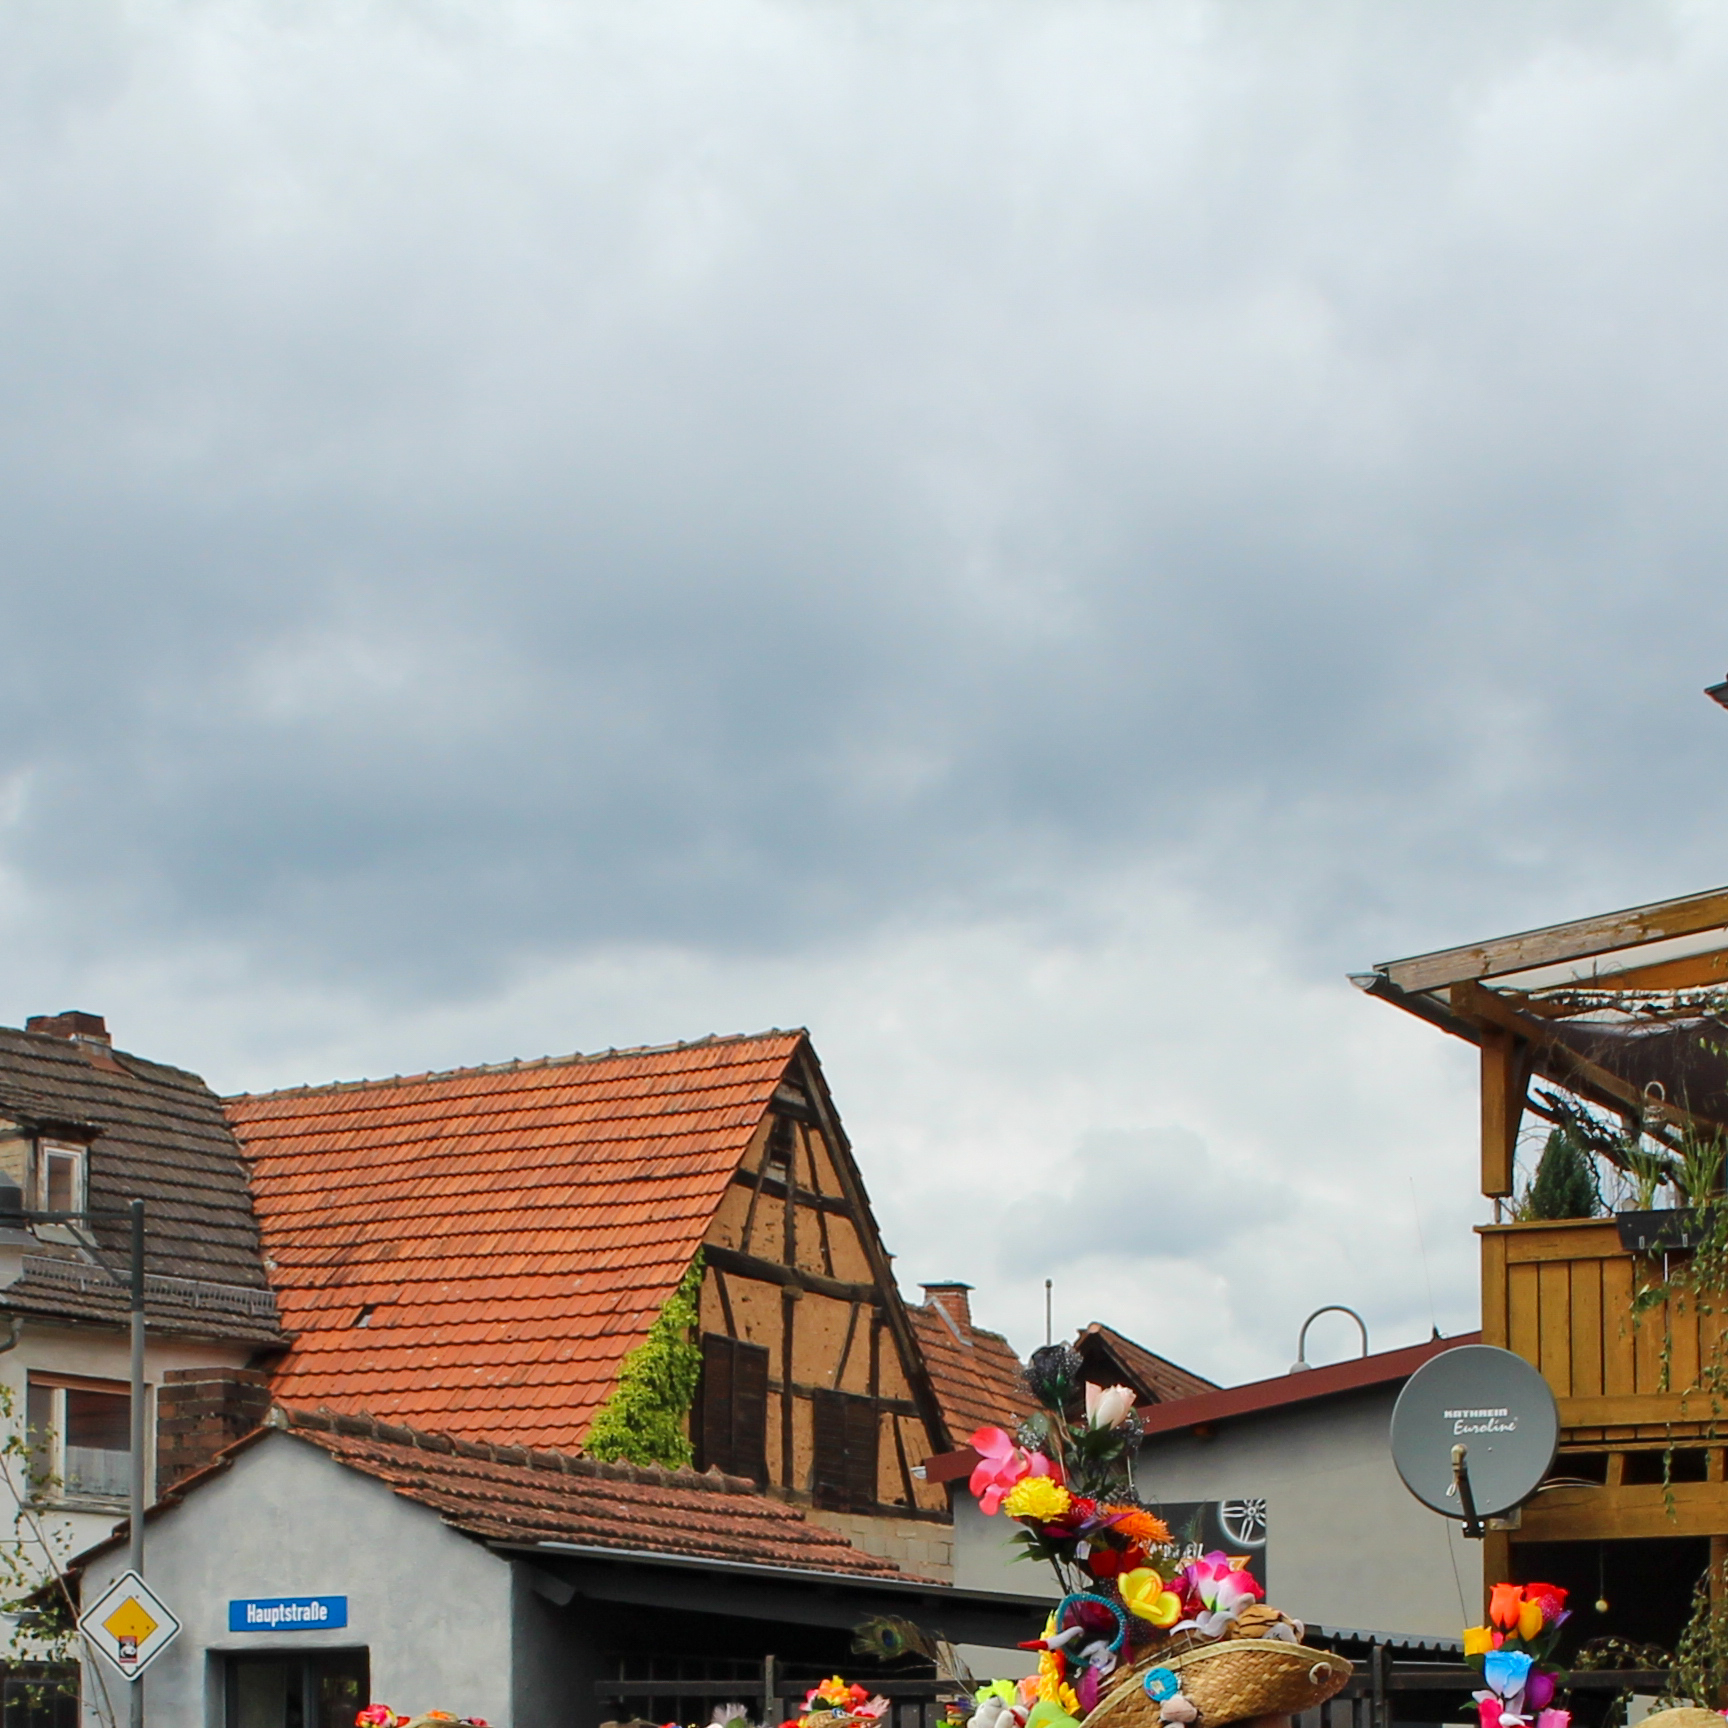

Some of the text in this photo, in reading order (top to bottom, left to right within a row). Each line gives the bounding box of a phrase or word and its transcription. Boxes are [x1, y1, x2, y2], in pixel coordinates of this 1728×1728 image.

[1443, 1407, 1509, 1419] KATHREIN
[1453, 1417, 1517, 1436] Euroline
[246, 1601, 328, 1628] Hauptstraße
